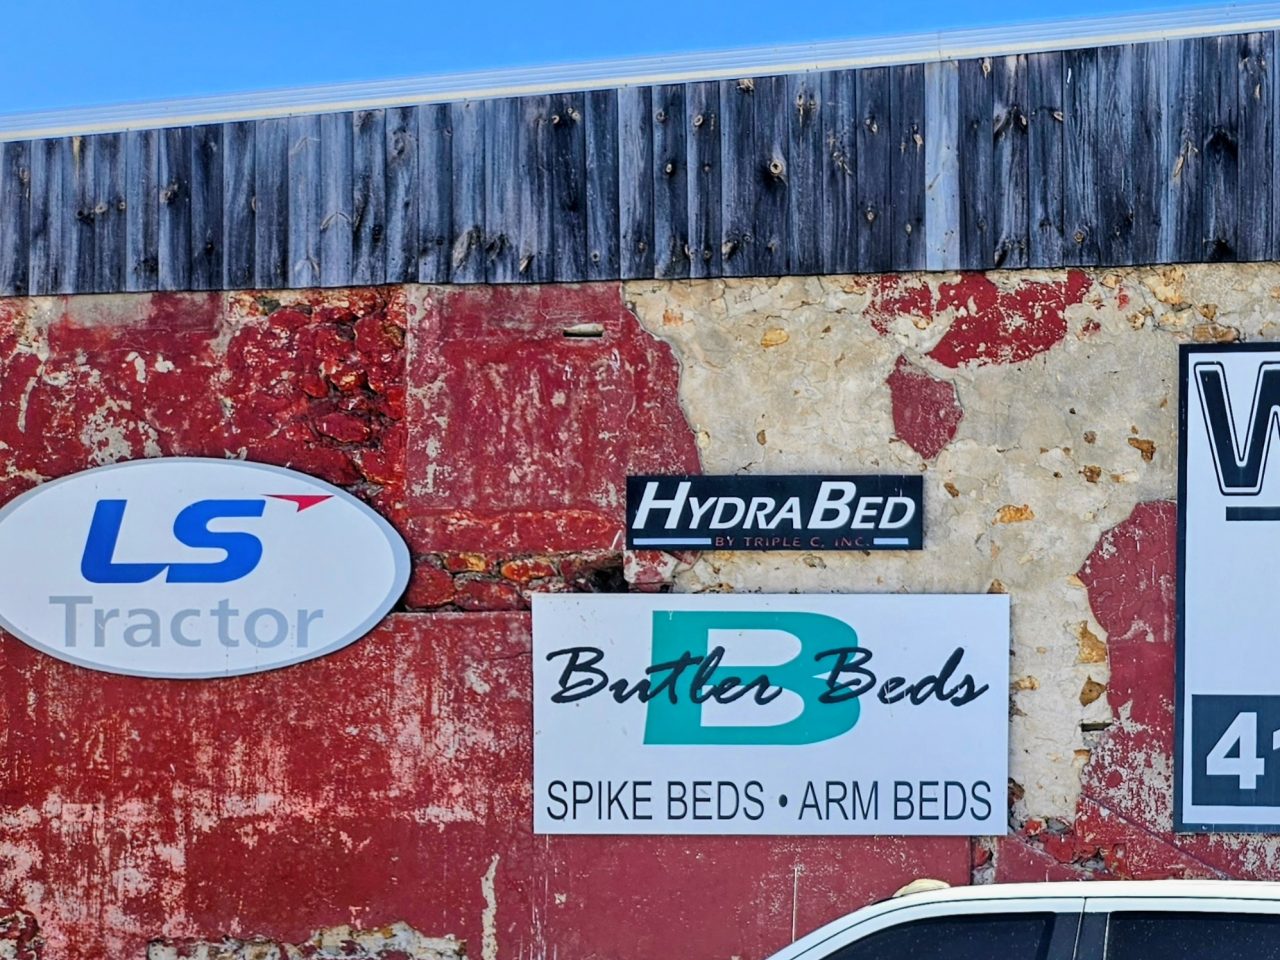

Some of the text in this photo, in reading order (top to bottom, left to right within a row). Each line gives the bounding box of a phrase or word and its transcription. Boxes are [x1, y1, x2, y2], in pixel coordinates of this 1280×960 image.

[80, 498, 266, 583] LS
[715, 537, 734, 546] BY
[744, 537, 801, 546] TRIPLE
[49, 595, 323, 648] Tractor
[545, 645, 989, 706] Butler Beds
[546, 780, 992, 821] SPIKE BEDS ARM BEDS
